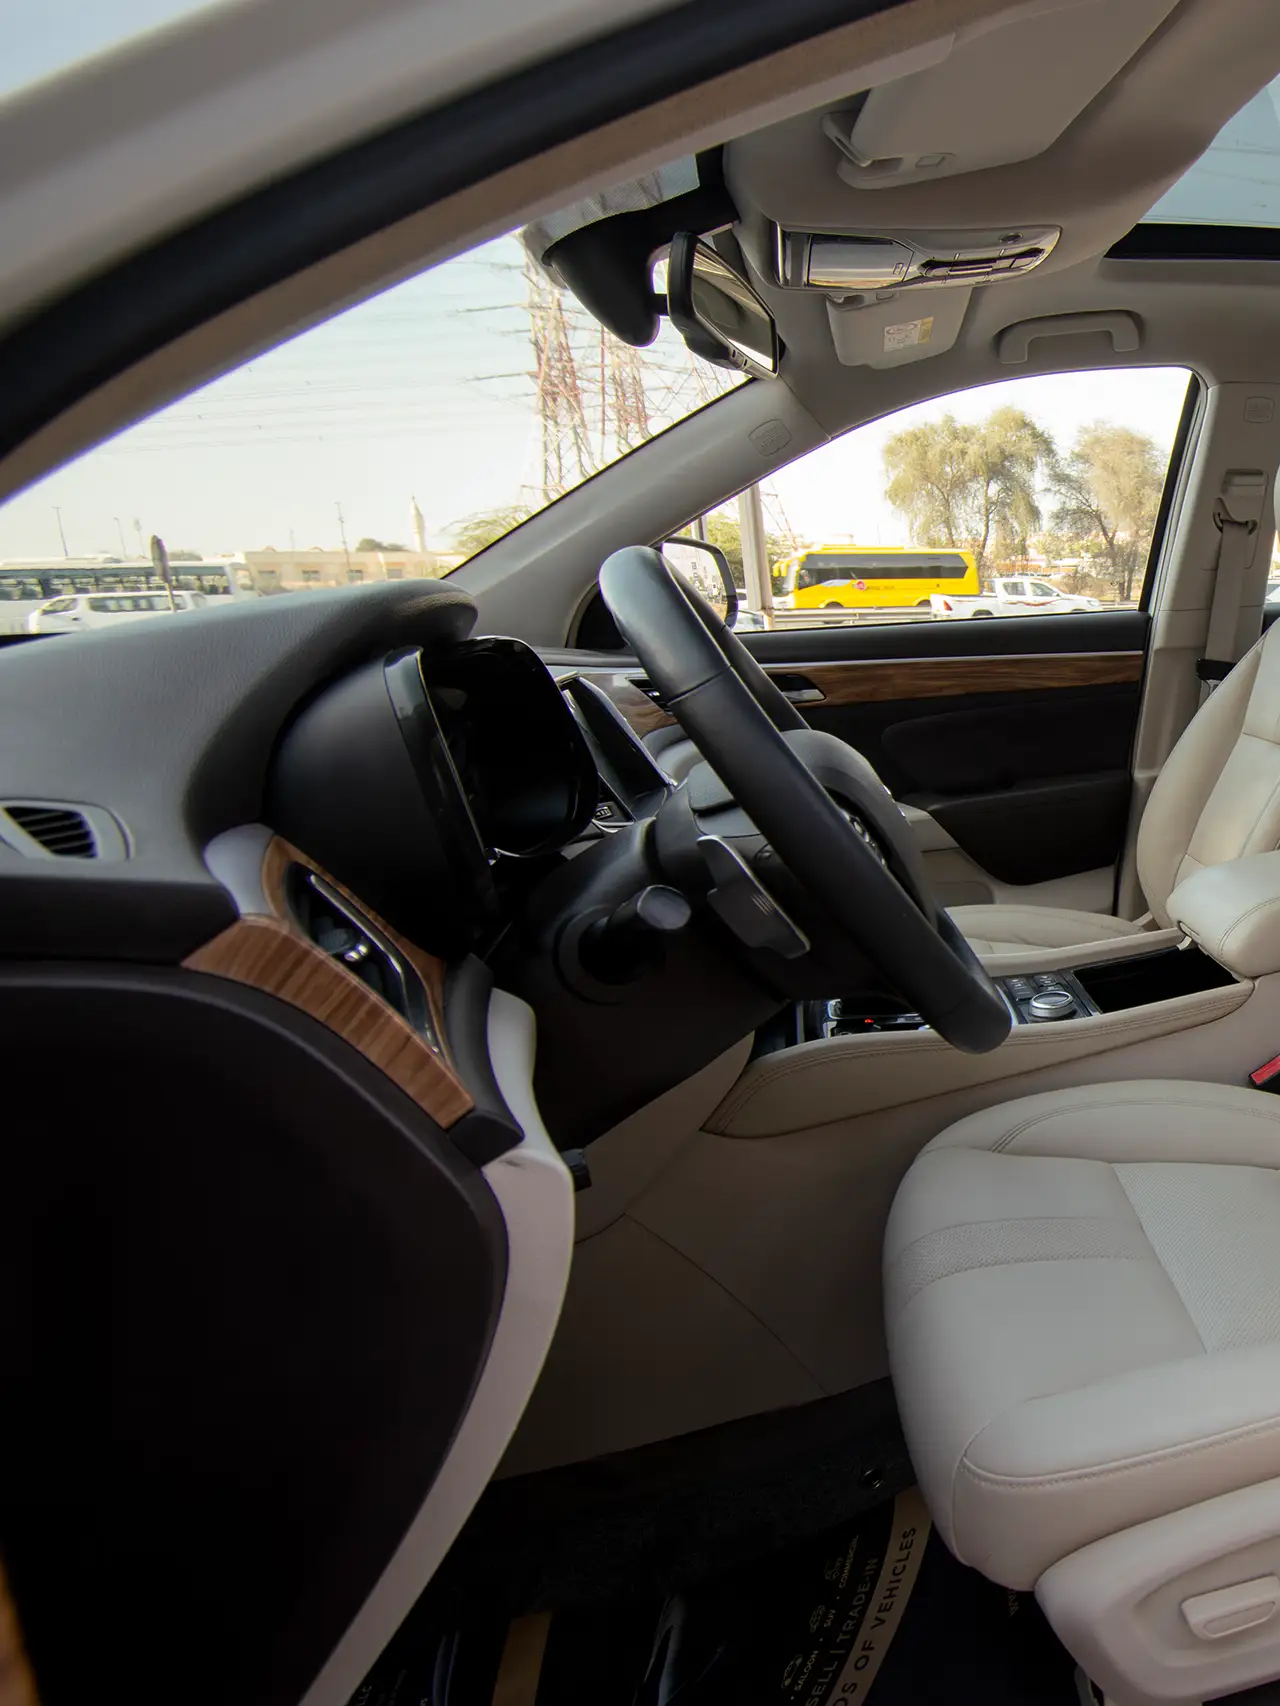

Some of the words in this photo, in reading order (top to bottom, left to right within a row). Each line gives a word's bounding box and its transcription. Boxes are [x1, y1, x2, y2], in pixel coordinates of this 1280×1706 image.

[836, 1556, 880, 1643] TRADE-IN
[854, 1640, 875, 1671] OF
[871, 1526, 917, 1631] VEHICLES
[793, 1649, 820, 1692] SALOON
[823, 1608, 837, 1628] SUV
